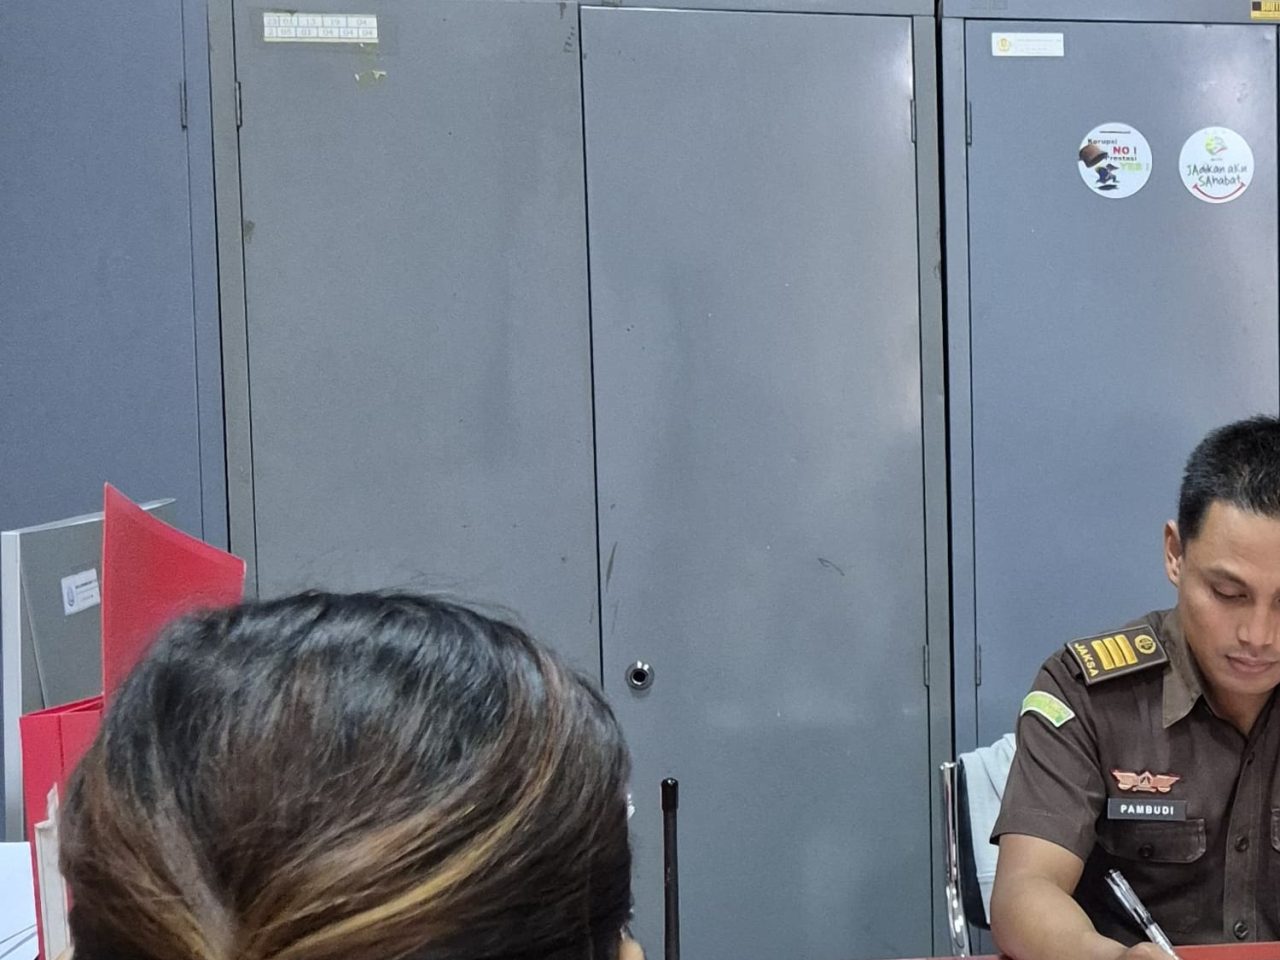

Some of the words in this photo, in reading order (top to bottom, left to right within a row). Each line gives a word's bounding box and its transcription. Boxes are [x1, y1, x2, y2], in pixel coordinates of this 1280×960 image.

[1113, 146, 1130, 155] NO
[1073, 642, 1099, 678] JAKSA
[1120, 804, 1174, 816] PAMBUDI
